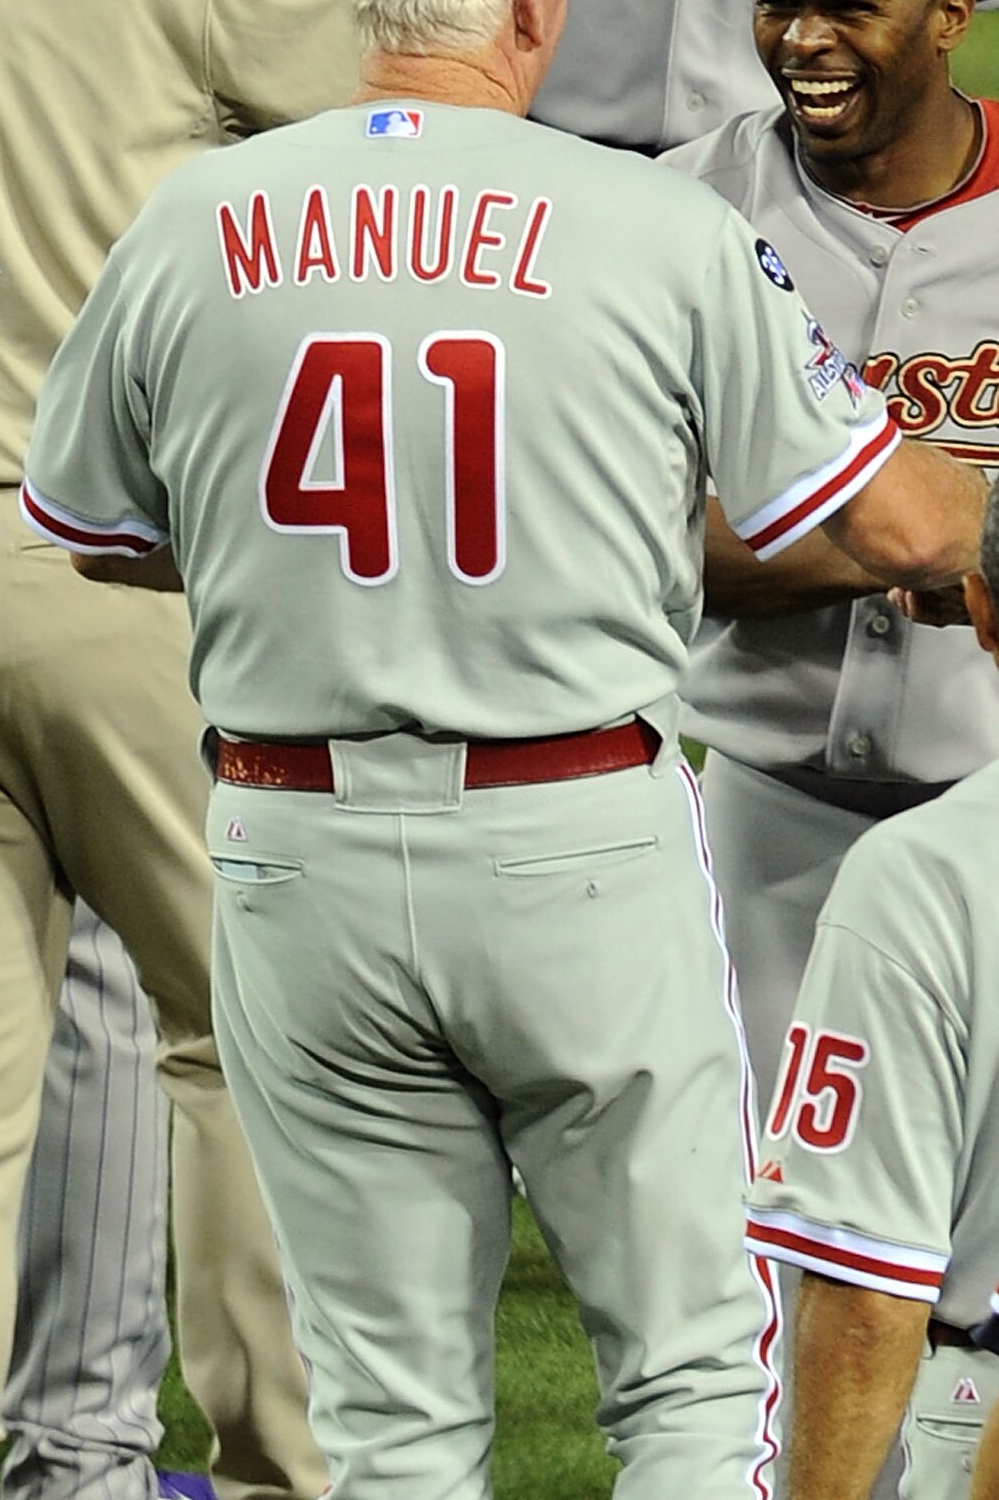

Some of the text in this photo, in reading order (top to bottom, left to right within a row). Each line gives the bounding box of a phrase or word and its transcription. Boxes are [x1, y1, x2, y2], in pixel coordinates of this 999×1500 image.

[215, 183, 554, 299] MANUEL
[862, 340, 999, 437] st
[259, 330, 507, 587] 41
[765, 1021, 871, 1155] 15
